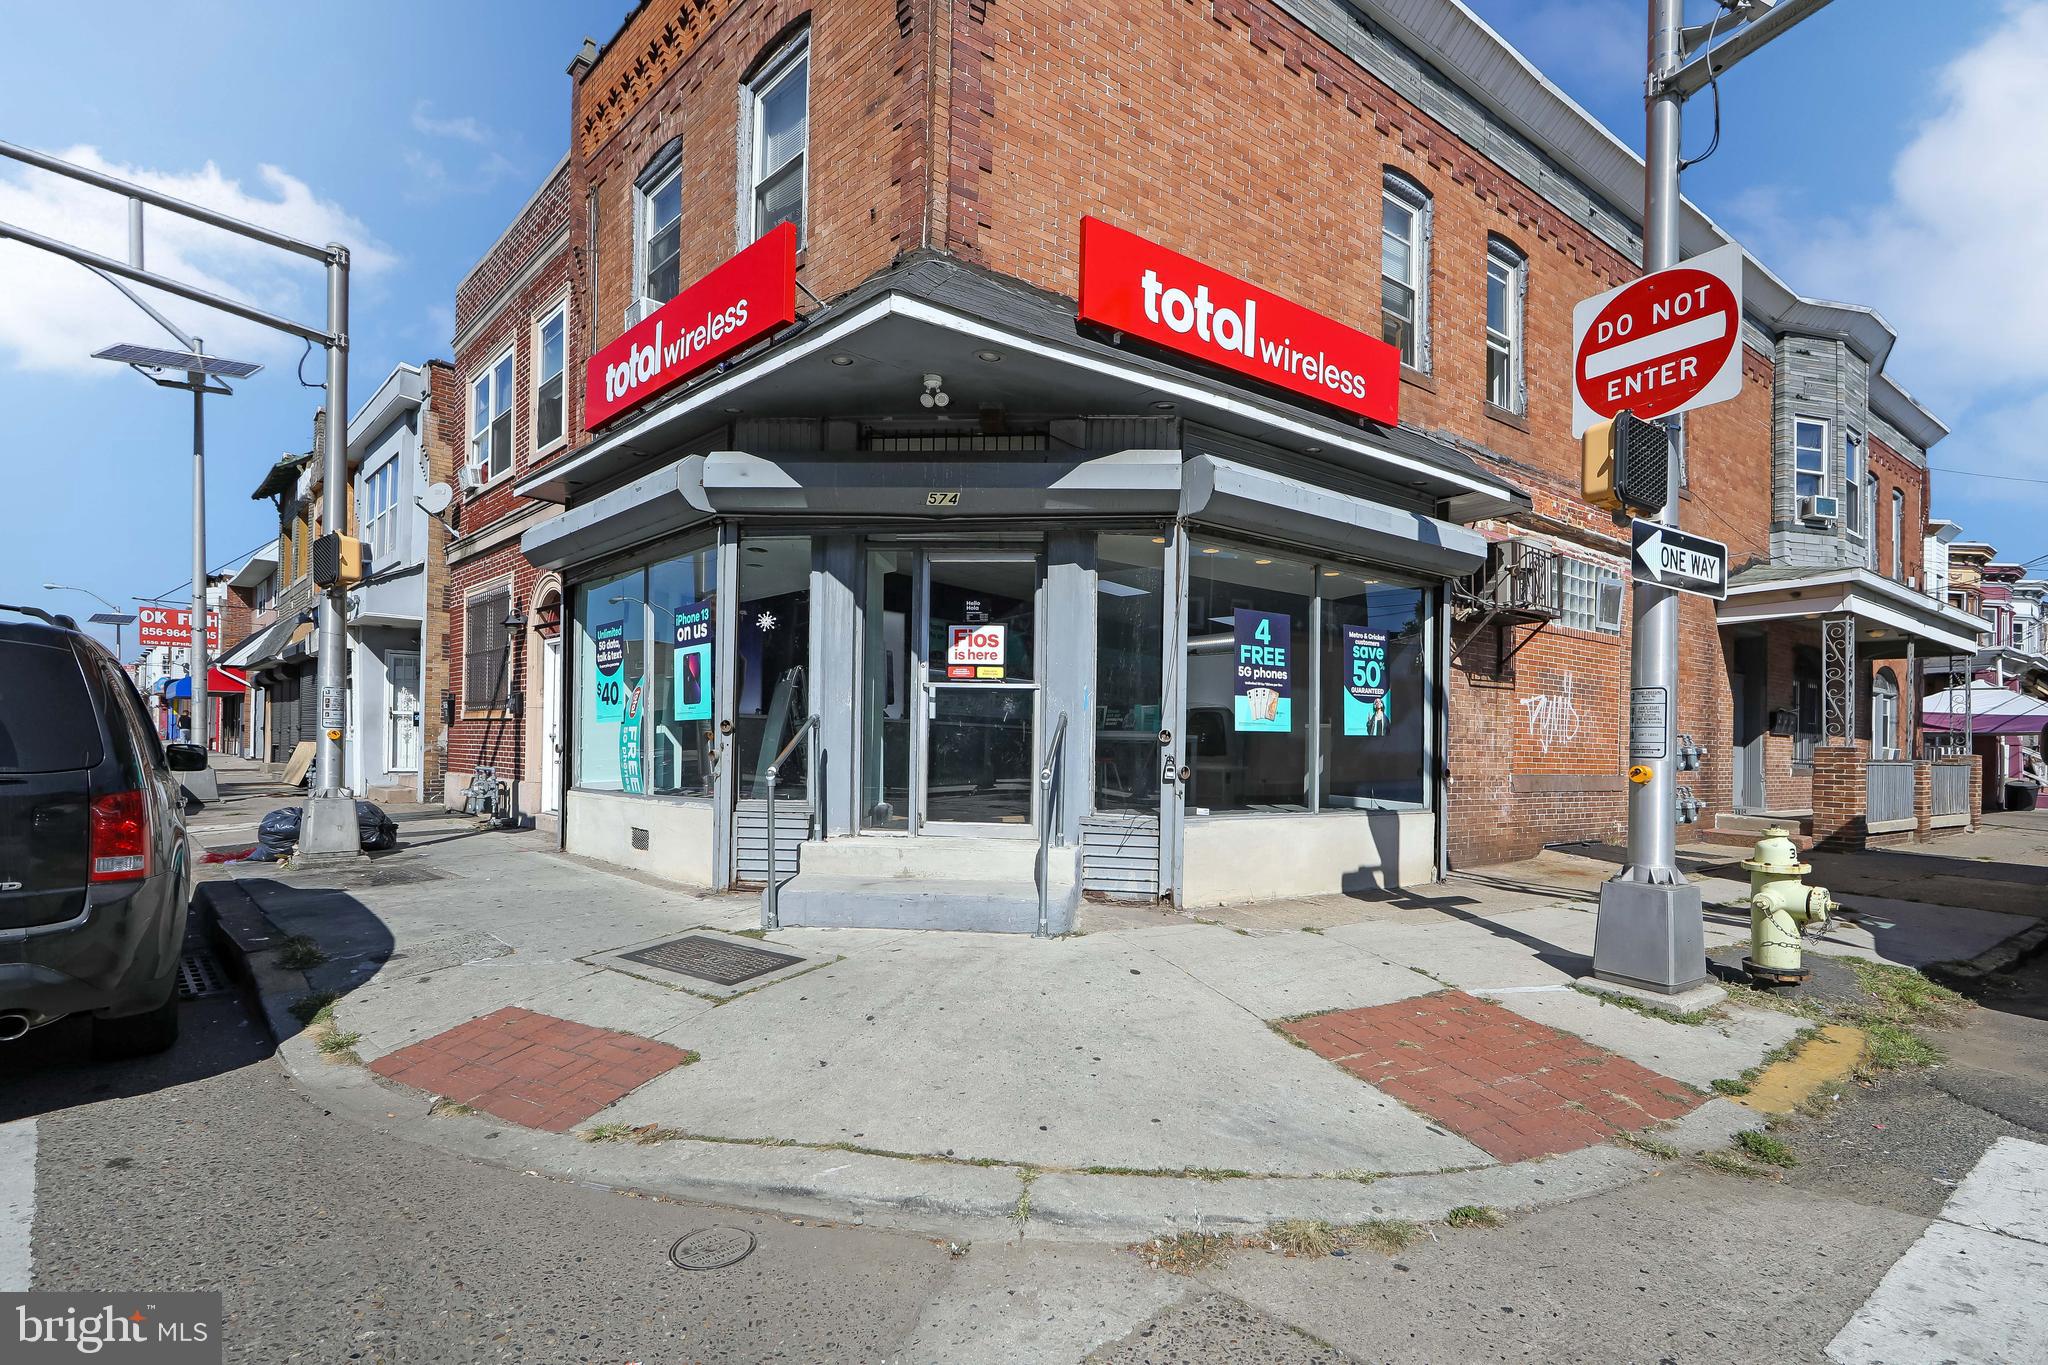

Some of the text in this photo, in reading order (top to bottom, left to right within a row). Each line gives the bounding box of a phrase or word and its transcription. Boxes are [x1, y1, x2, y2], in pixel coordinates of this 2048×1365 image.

[1597, 284, 1711, 344] DO NOT
[1141, 269, 1366, 399] total wireless
[606, 299, 748, 402] total wireless
[1607, 356, 1698, 402] ENTER
[928, 493, 959, 505] 574
[1661, 546, 1717, 580] ONE WAY
[140, 610, 218, 628] OK FIH
[675, 608, 709, 627] iPhone 13
[597, 625, 622, 640] Unlimited
[676, 623, 708, 642] on us
[953, 628, 1000, 648] Fios
[1254, 618, 1271, 645] 4
[1348, 631, 1363, 639] Metro
[598, 640, 606, 651] 5G
[954, 649, 998, 660] is here
[1352, 645, 1384, 660] save
[1240, 644, 1286, 667] FREE
[1238, 665, 1288, 680] 5G phones
[596, 680, 619, 706] $40
[1350, 686, 1385, 695] GUARANTEED
[630, 689, 640, 715] total
[627, 725, 641, 792] FREE
